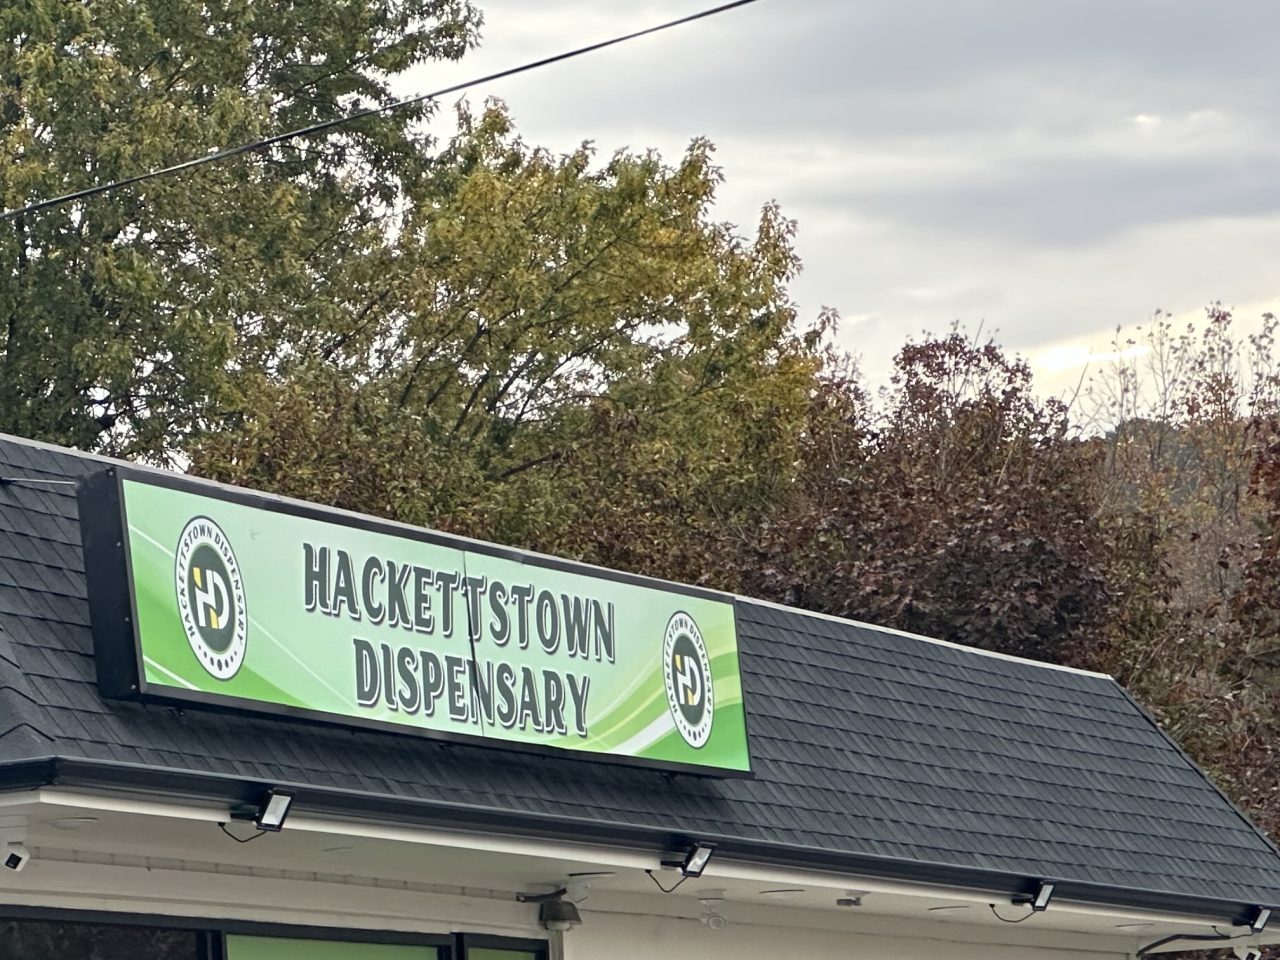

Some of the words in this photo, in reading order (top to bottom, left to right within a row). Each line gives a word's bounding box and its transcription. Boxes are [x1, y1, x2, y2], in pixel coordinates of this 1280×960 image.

[179, 524, 212, 638] HACKETTSTOWN
[215, 533, 245, 645] DISPENSARY
[193, 567, 229, 629] HD
[302, 541, 616, 663] HACKETTSTOWN
[353, 638, 591, 737] DISPENSARY
